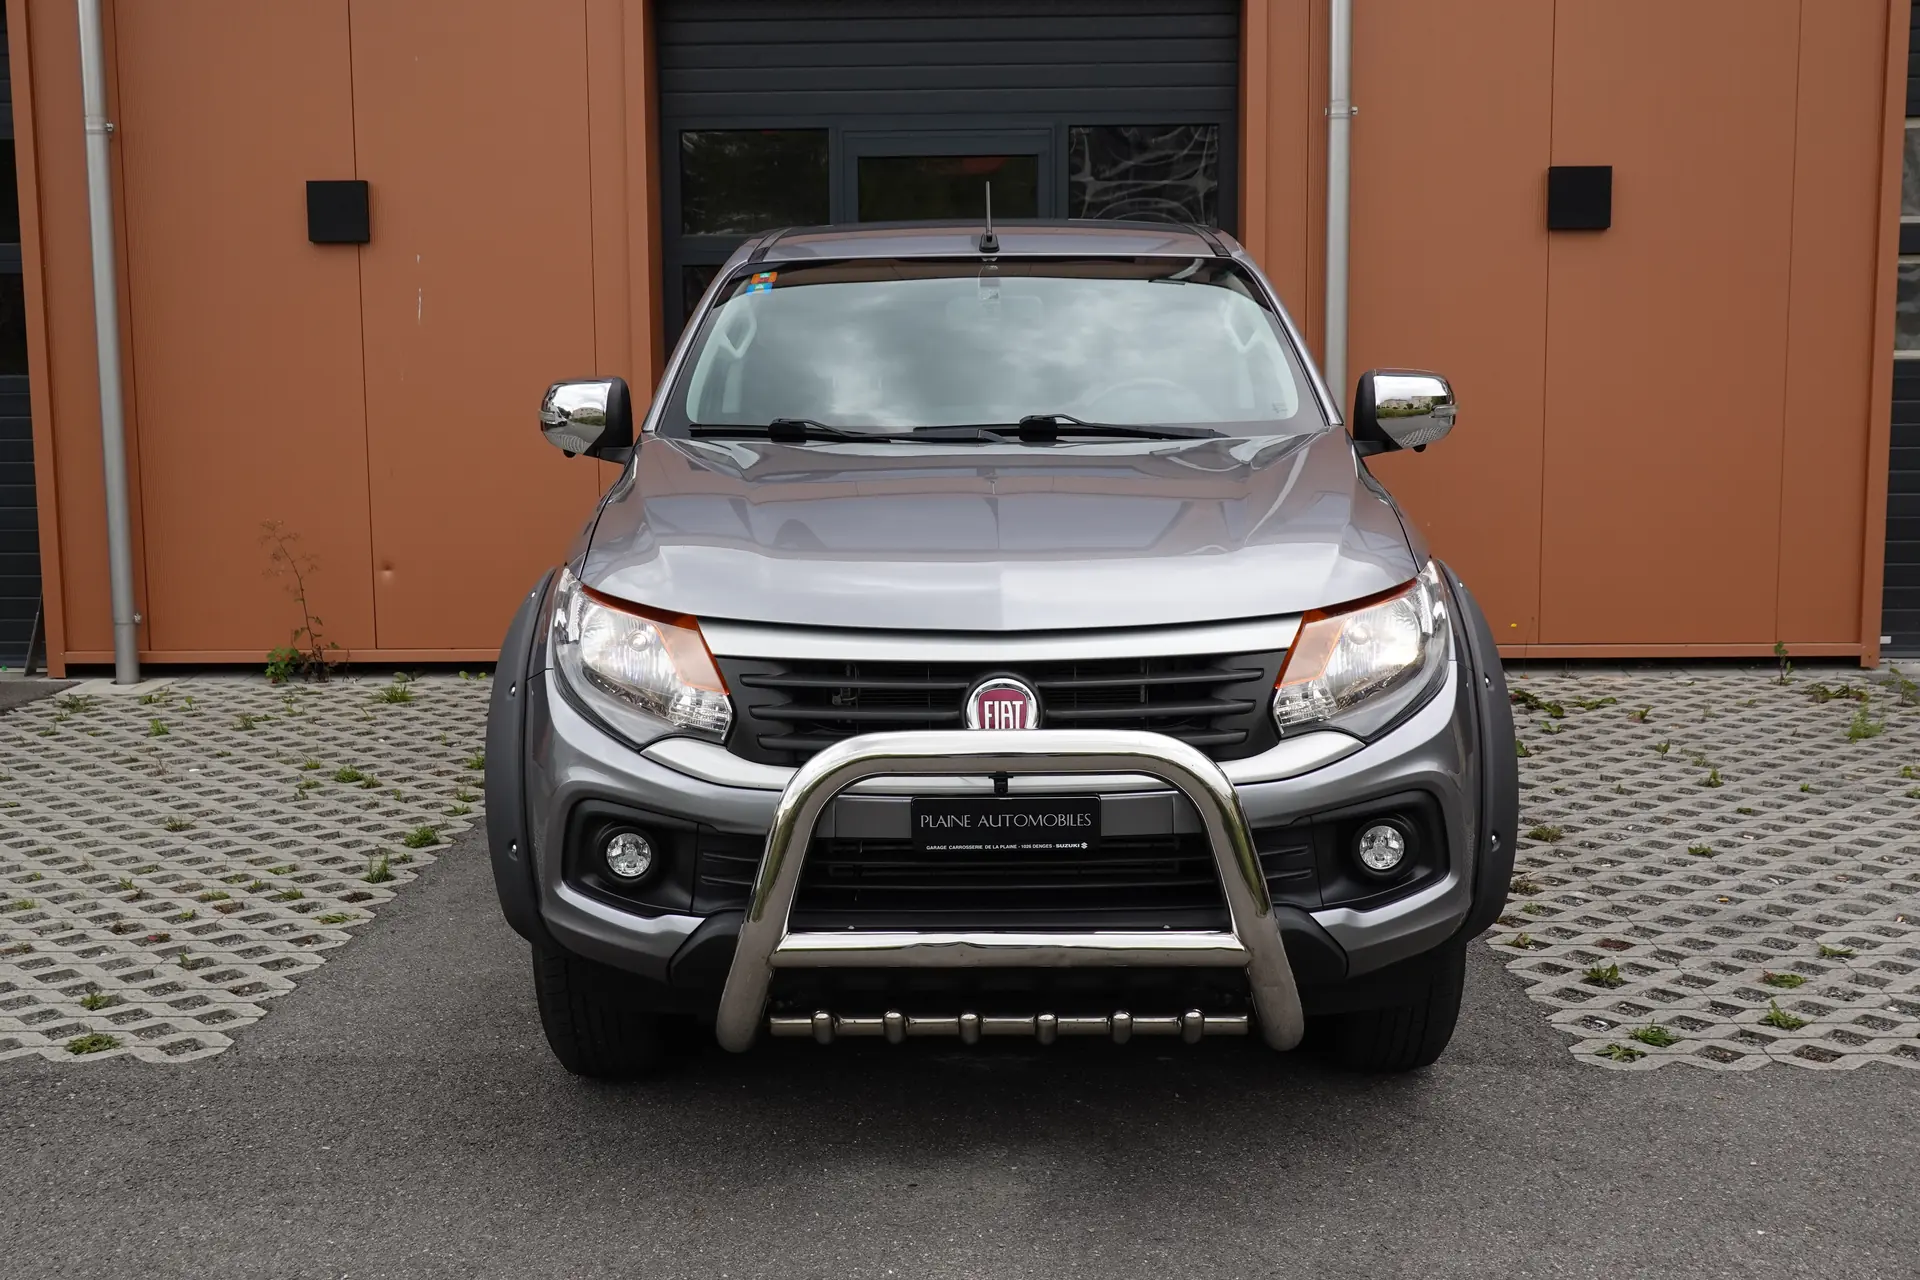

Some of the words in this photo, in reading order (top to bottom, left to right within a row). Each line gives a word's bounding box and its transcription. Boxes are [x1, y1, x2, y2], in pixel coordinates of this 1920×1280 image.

[984, 700, 1024, 730] FIAT
[920, 814, 972, 828] PLAINE
[977, 813, 1092, 828] AUTOMOBILES
